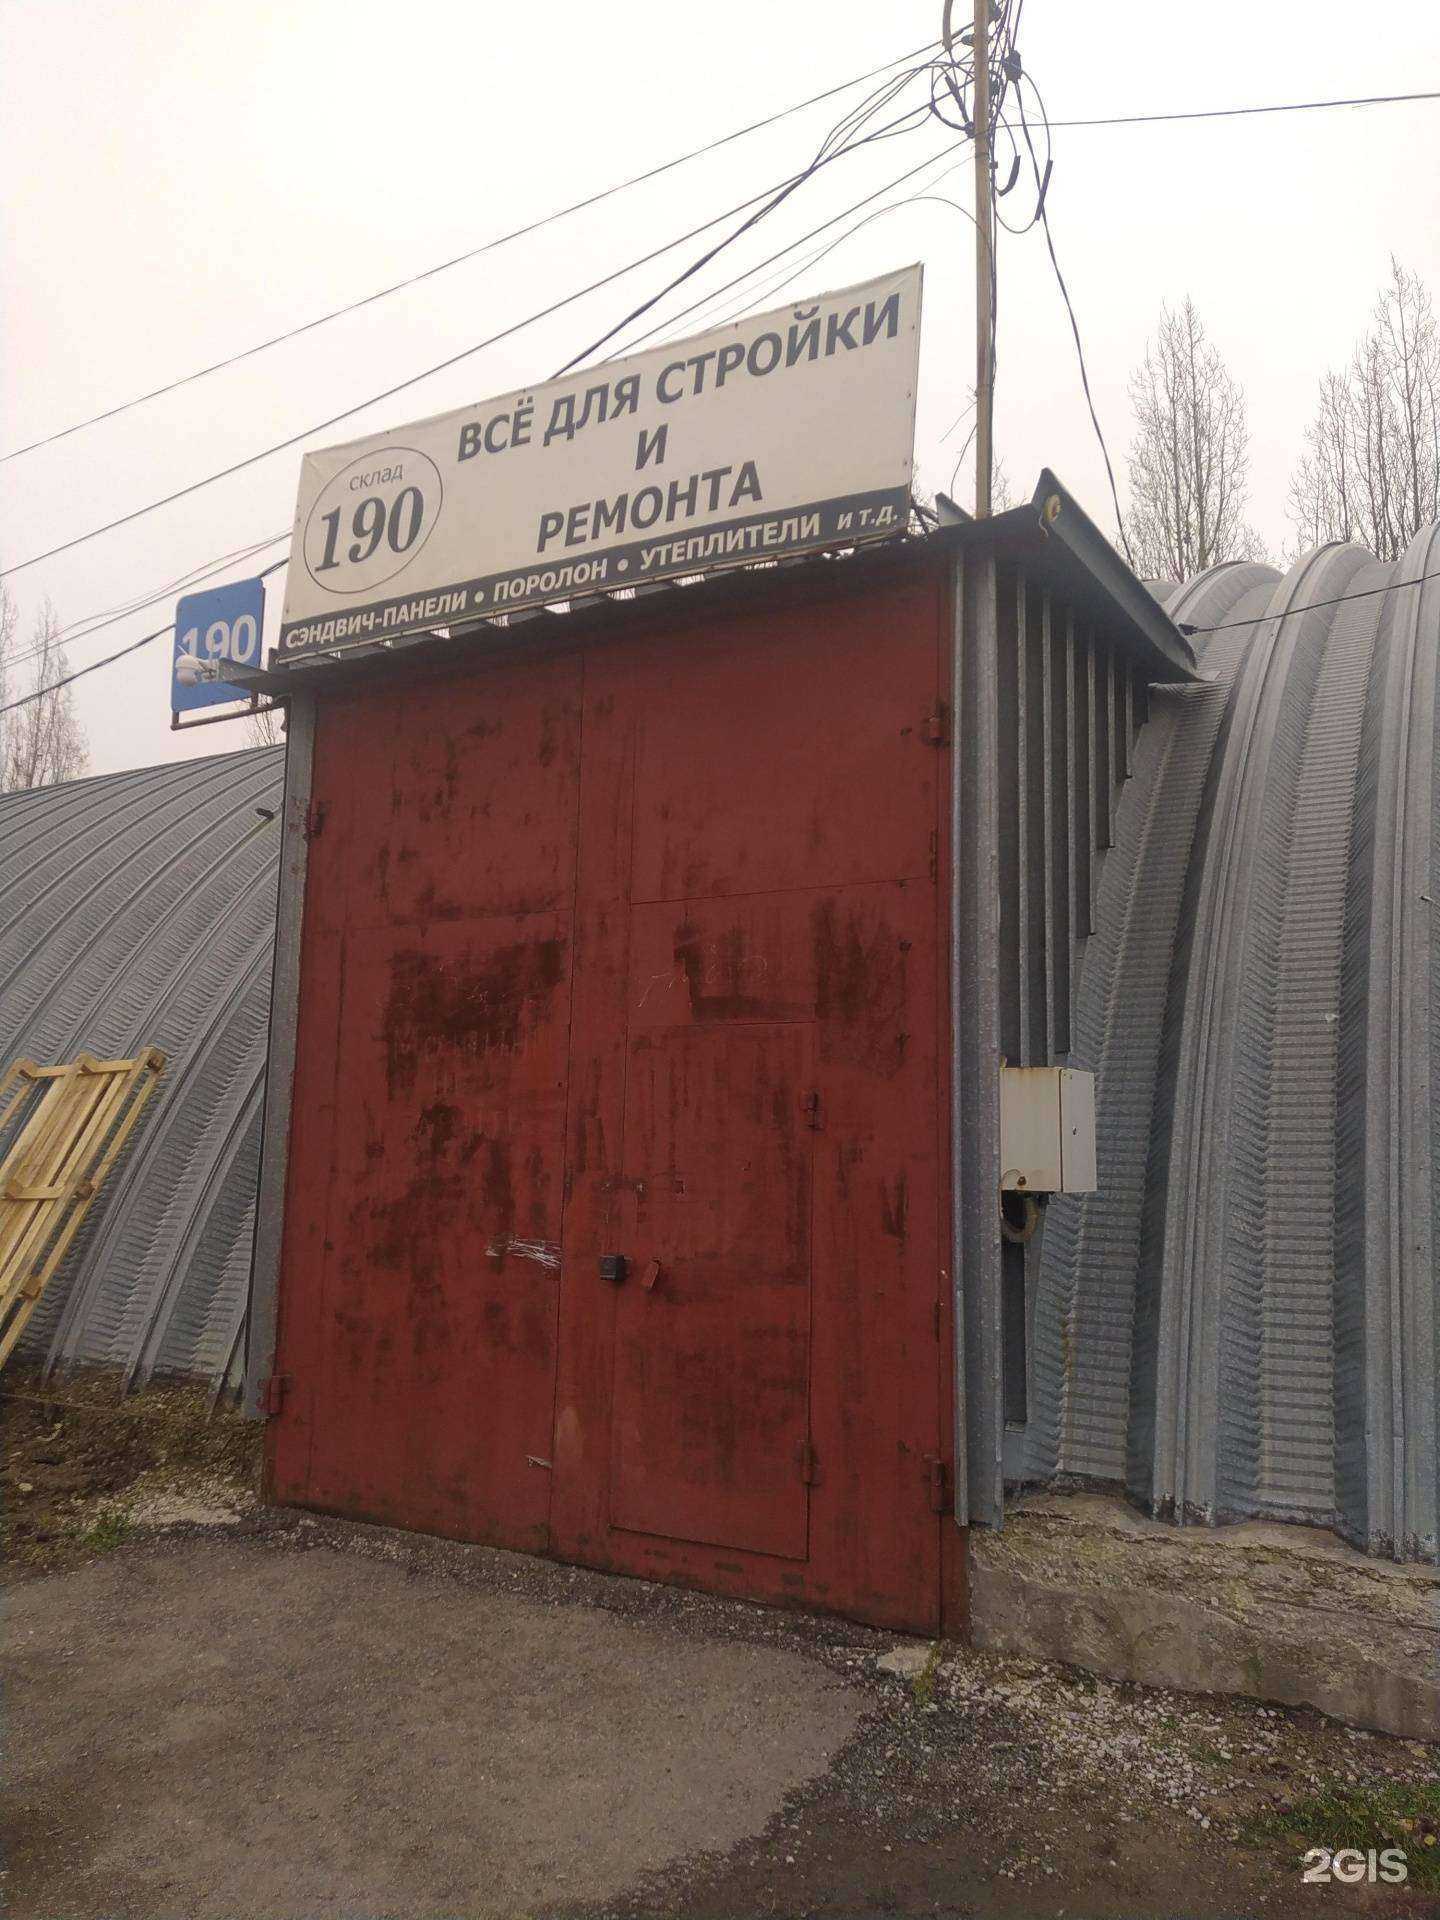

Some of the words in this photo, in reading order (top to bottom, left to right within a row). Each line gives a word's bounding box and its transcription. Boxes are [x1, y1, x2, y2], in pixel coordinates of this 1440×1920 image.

[457, 396, 535, 463] ВСЁ
[543, 373, 642, 447] ДЛЯ
[655, 293, 901, 404] СТРОЙКИ
[349, 464, 403, 491] склад
[635, 423, 669, 471] И
[314, 486, 424, 573] 190
[536, 460, 763, 553] РЕМОНТА
[285, 590, 467, 649] СЭНДВИЧ-ПАНЕЛИ
[493, 558, 608, 602] ПОРОЛОН
[640, 512, 820, 570] УТЕПЛИТЕЛИ
[181, 614, 257, 663] 190
